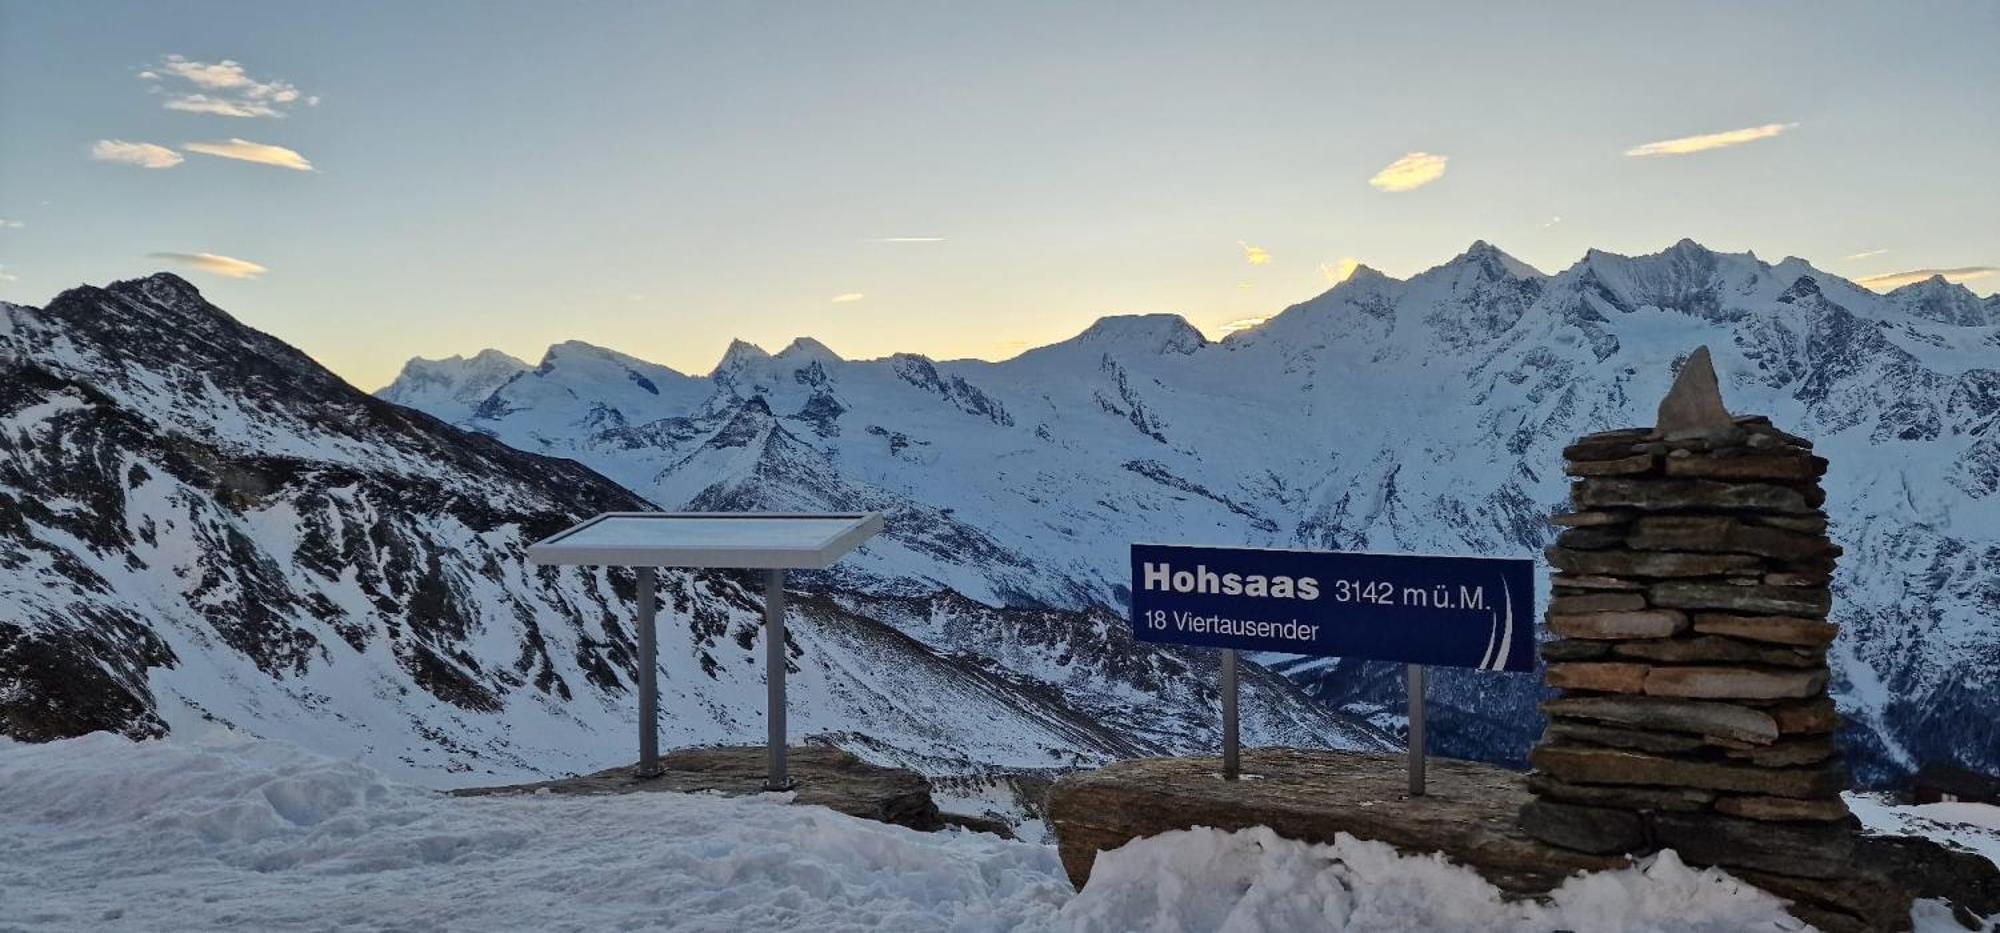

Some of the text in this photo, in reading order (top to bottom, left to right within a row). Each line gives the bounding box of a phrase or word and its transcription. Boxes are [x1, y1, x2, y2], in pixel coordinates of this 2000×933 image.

[1143, 562, 1320, 601] Hohsaas
[1335, 579, 1394, 605] 3142
[1145, 610, 1319, 641] 18 Viertausender
